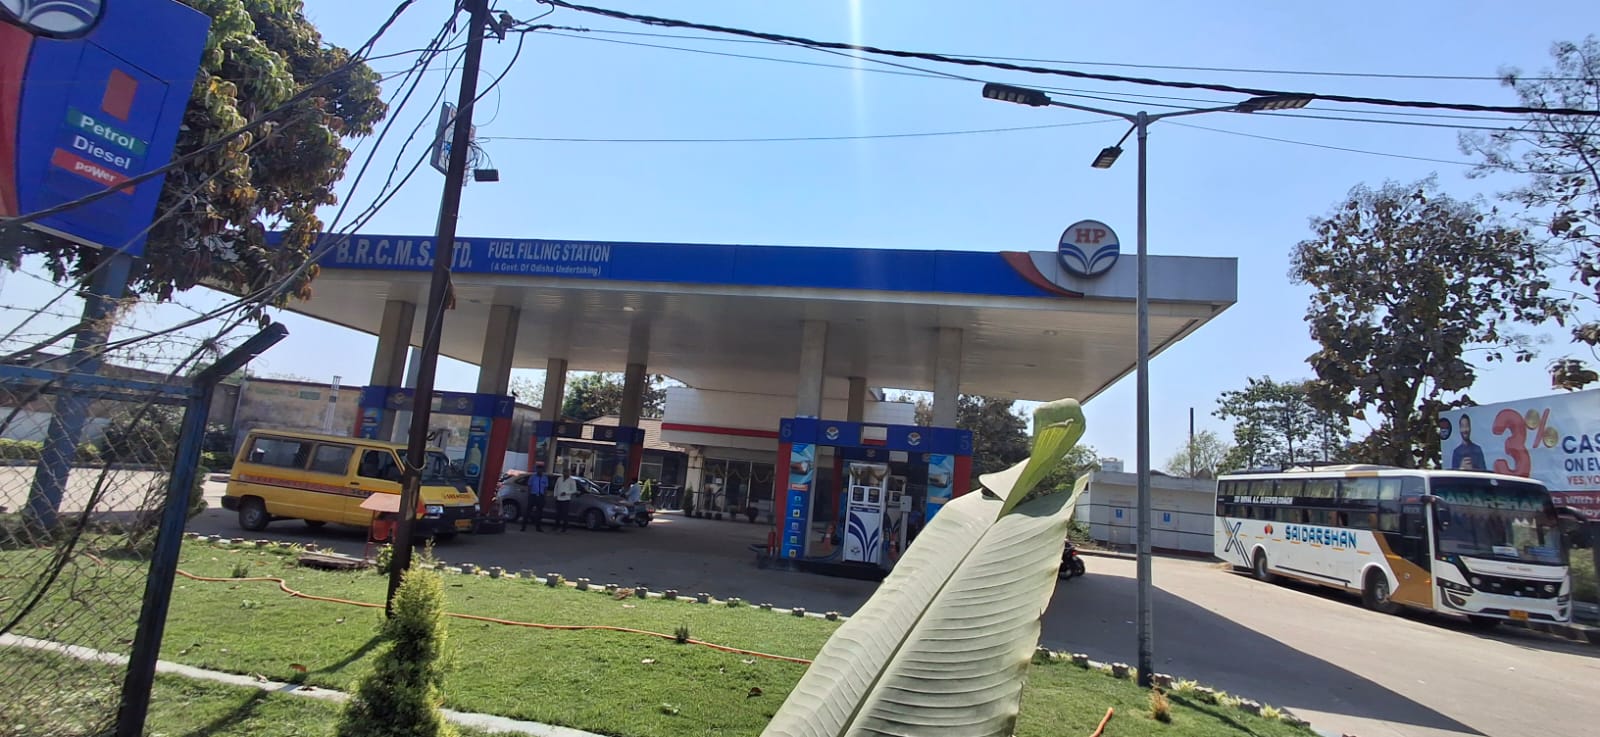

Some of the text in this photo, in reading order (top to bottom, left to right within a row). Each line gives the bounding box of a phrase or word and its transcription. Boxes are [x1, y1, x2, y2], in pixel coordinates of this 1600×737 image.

[80, 114, 136, 150] Petrol
[73, 135, 131, 170] Diesel
[1074, 228, 1106, 243] HP
[336, 238, 472, 268] B.R.C.M.S. TD.
[488, 241, 611, 262] FUEL FILLING STATION
[501, 262, 519, 272] Govt.
[530, 263, 554, 273] Odisha
[782, 423, 792, 438] 6
[960, 435, 970, 450] 5
[1565, 458, 1584, 472] ON
